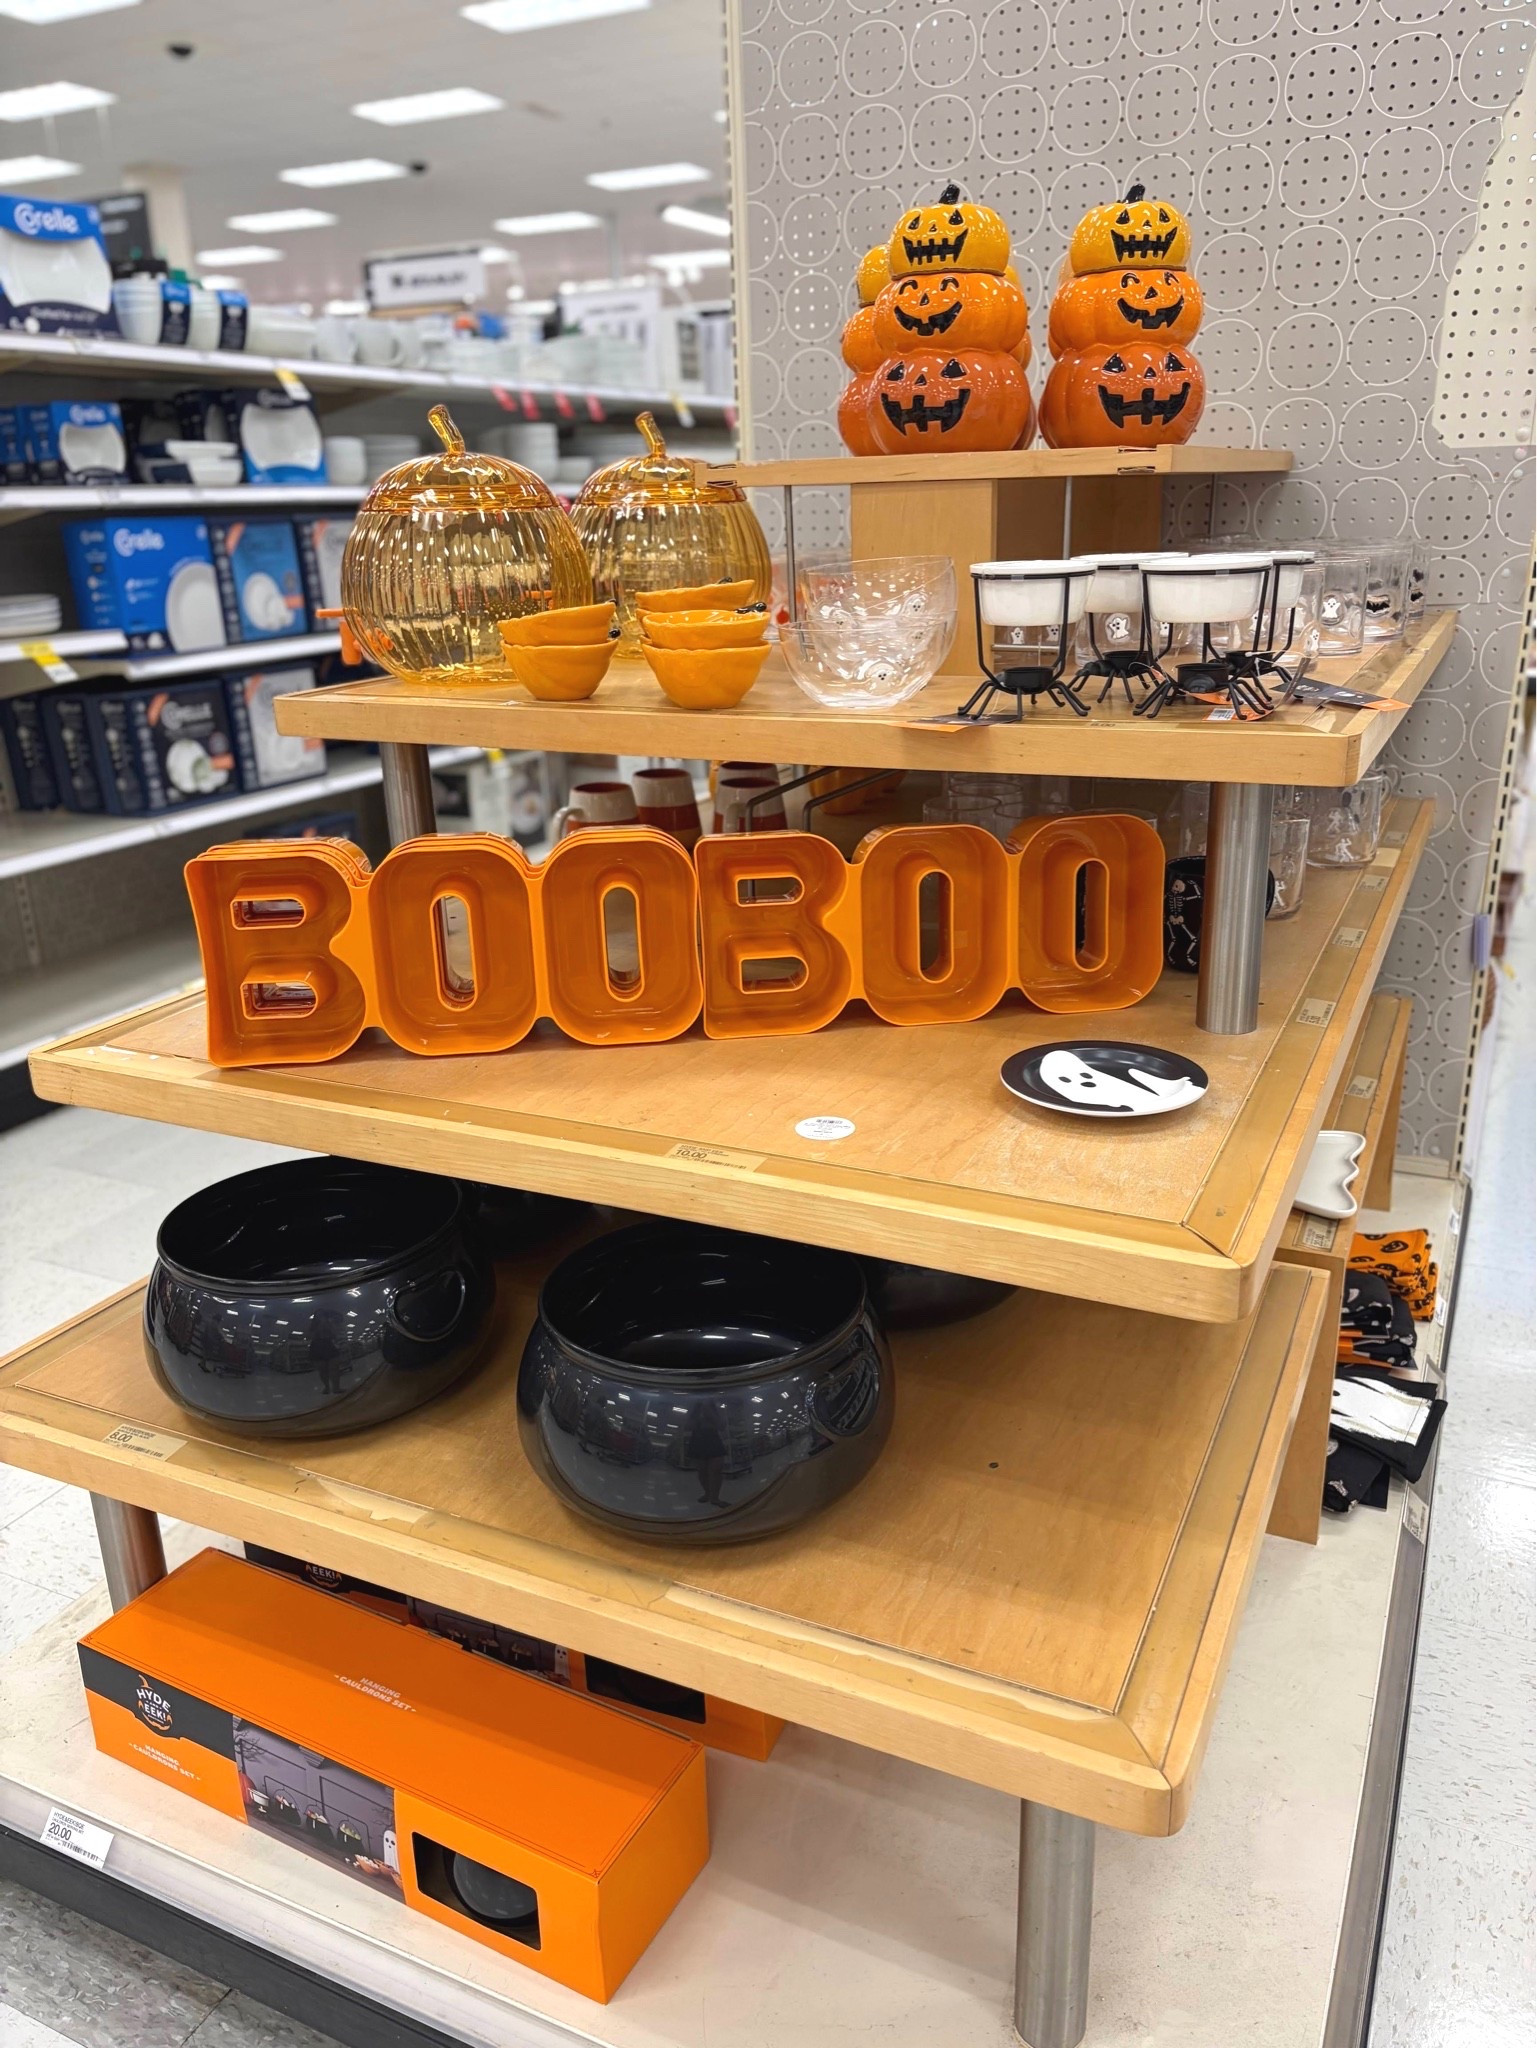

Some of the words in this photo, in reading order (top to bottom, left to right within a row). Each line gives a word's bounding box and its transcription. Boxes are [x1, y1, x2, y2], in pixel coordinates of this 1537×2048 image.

[13, 202, 80, 236] Corelle
[113, 528, 165, 557] Corelle
[697, 813, 1165, 1039] BOO
[184, 825, 702, 1067] BOO
[675, 1149, 708, 1158] 10.00
[109, 1431, 133, 1443] 8.00
[312, 1566, 336, 1579] EEK!
[339, 1676, 393, 1703] CAULDRONS
[391, 1699, 412, 1711] SET
[359, 1677, 402, 1699] HANGING
[136, 1688, 171, 1713] HYDE
[144, 1703, 167, 1722] EEK!
[133, 1744, 179, 1771] CAULDRONS
[179, 1768, 195, 1779] SET
[144, 1744, 180, 1766] HANGING
[48, 1822, 72, 1840] 20.00
